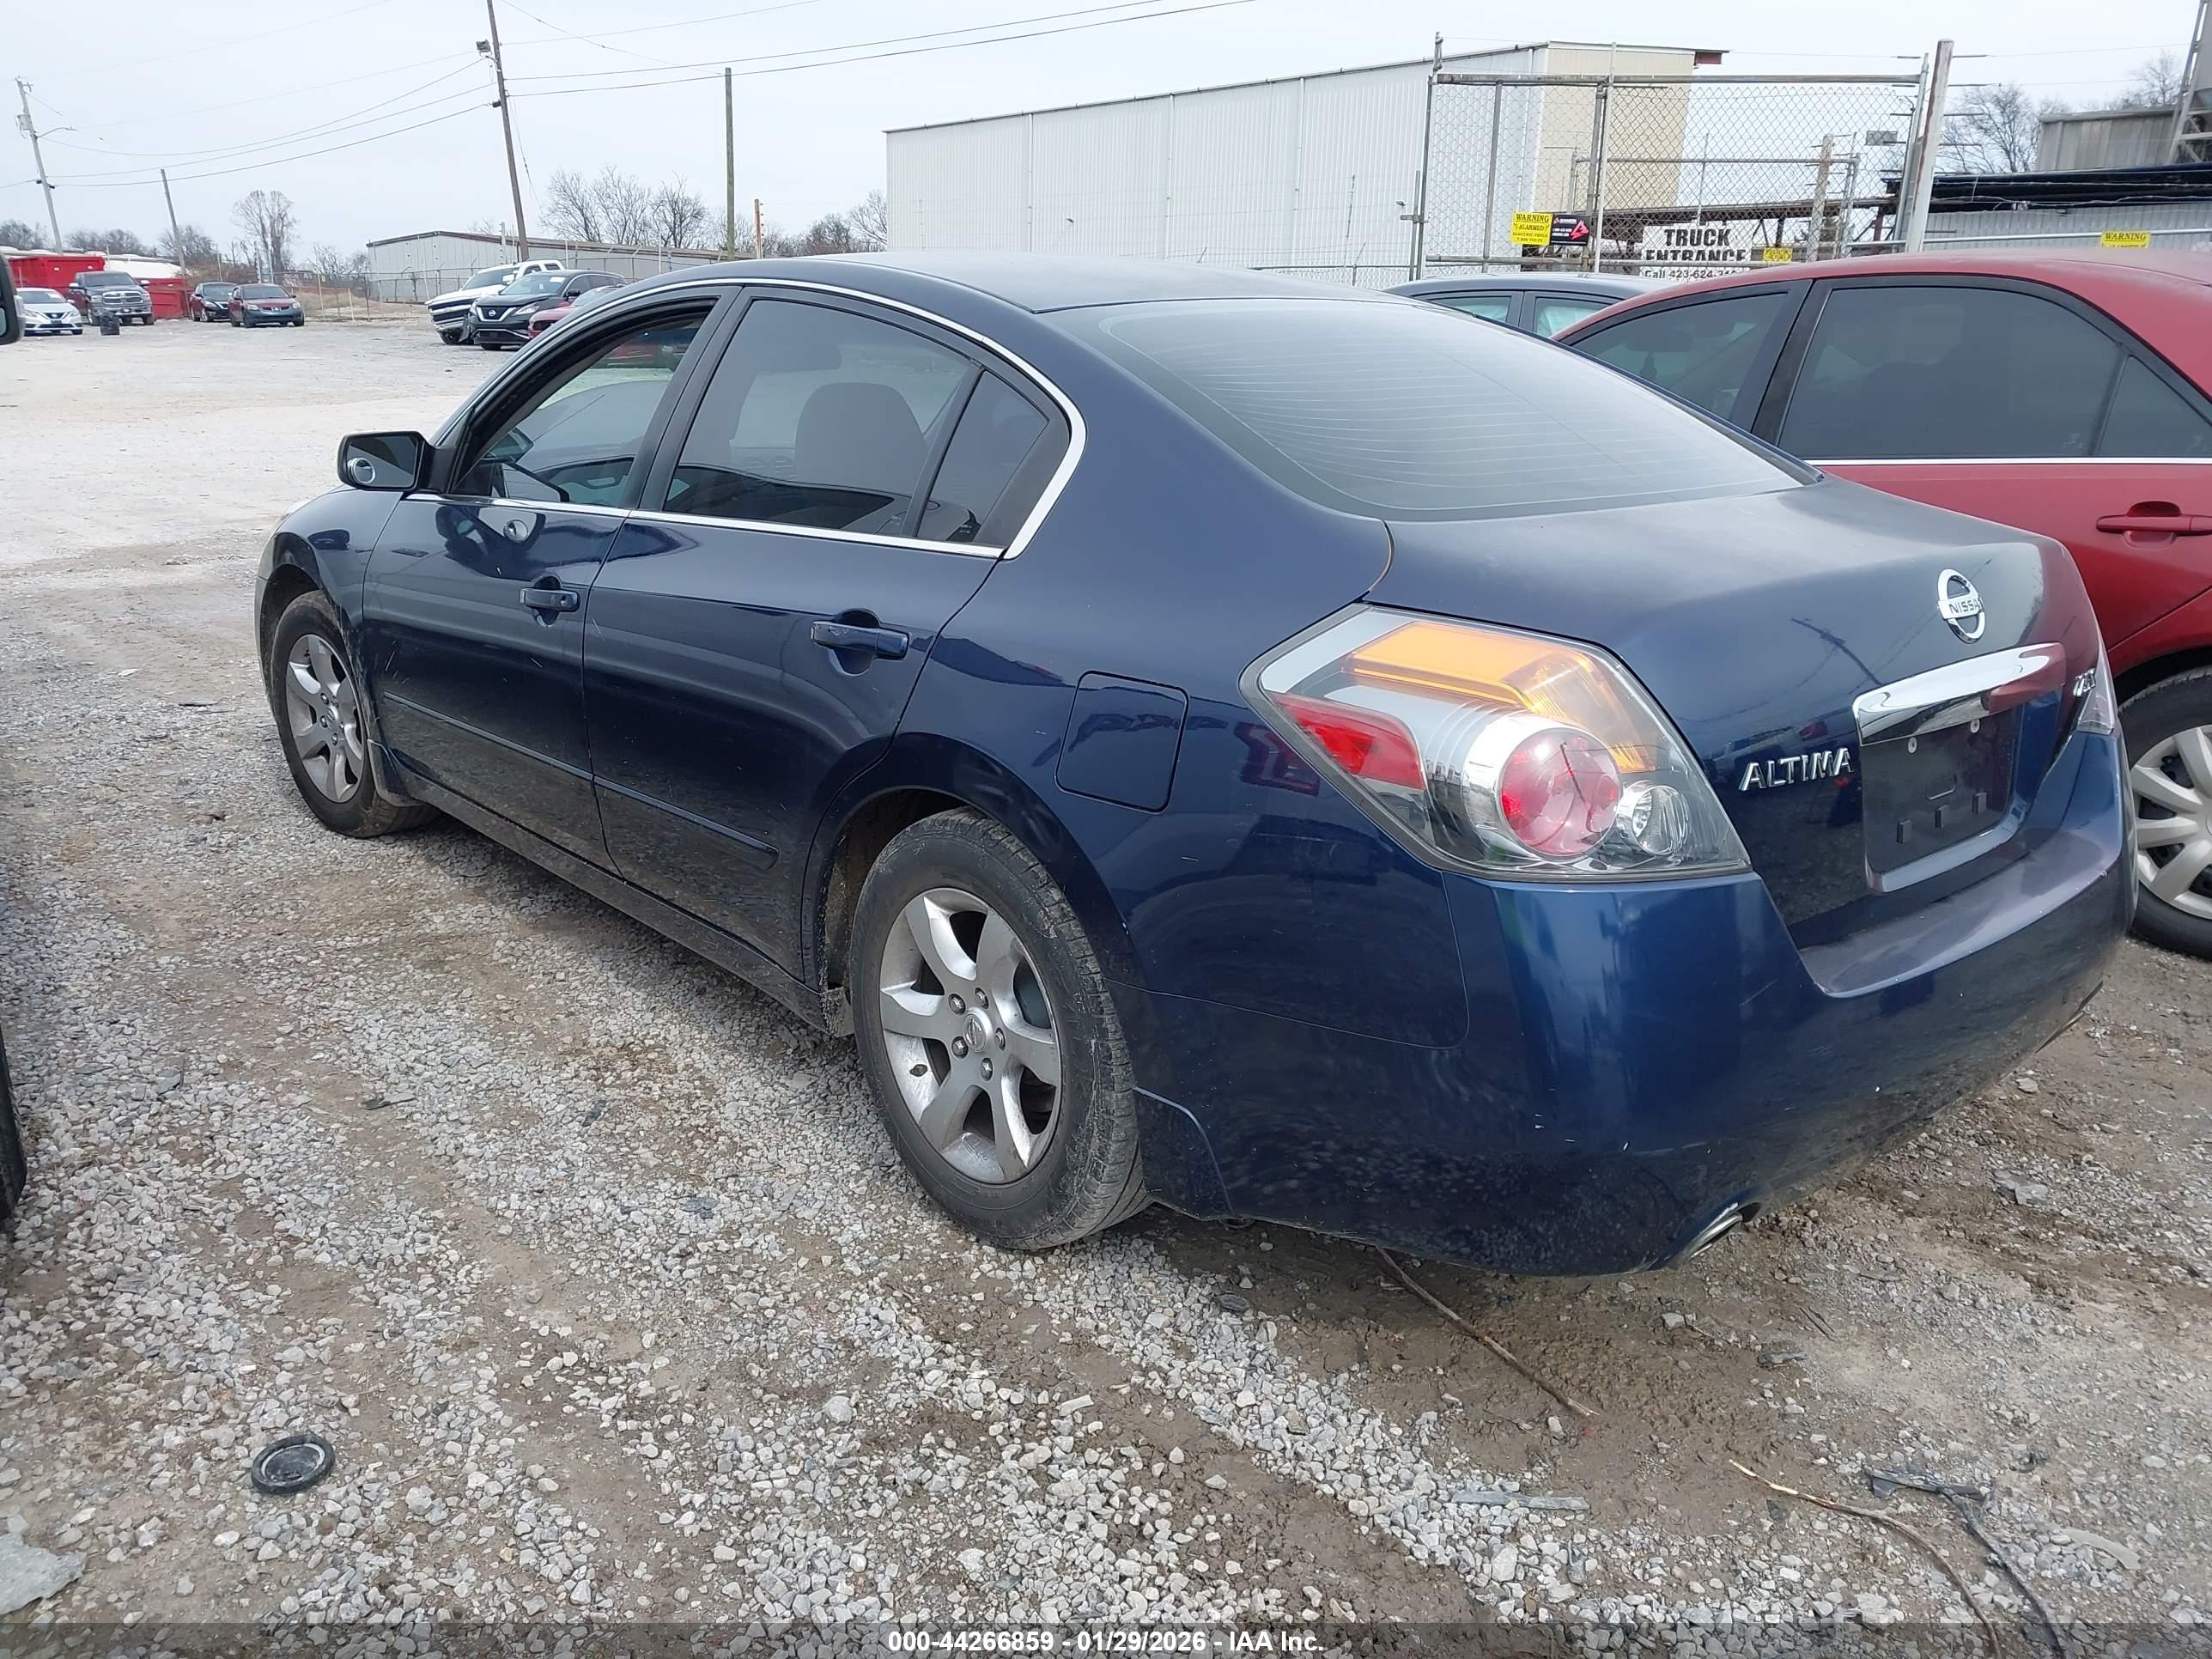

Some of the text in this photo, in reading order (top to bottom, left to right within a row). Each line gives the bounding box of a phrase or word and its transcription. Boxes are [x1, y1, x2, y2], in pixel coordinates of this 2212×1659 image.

[1516, 214, 1549, 222] WARNING
[1664, 228, 1731, 246] TRUCK
[1645, 249, 1747, 261] ENTRANCE
[1644, 269, 1665, 279] Call
[1738, 746, 1855, 792] ALTIMA
